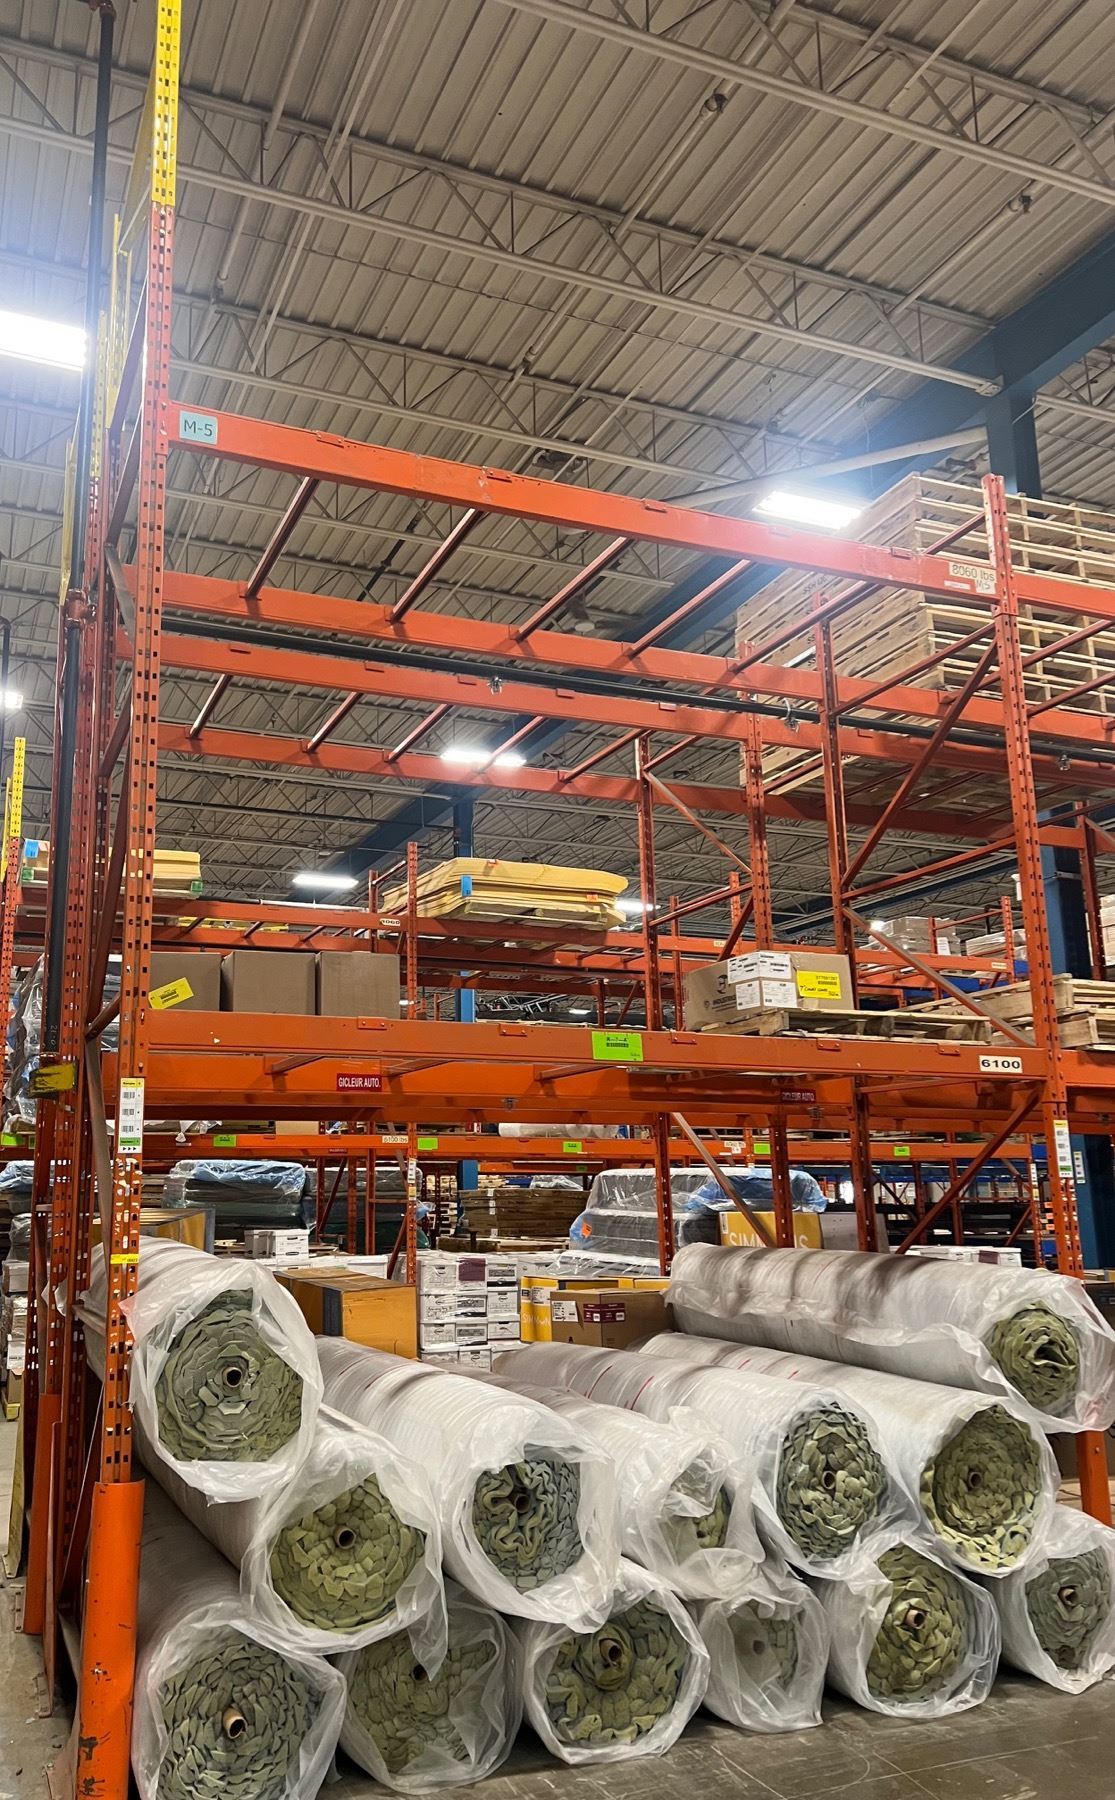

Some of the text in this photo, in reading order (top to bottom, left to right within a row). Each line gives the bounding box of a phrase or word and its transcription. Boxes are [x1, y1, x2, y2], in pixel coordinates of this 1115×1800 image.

[184, 419, 213, 437] M-5
[952, 564, 995, 581] 8060 lbs
[981, 1059, 1020, 1069] 6100
[338, 1076, 364, 1088] GICLEUR
